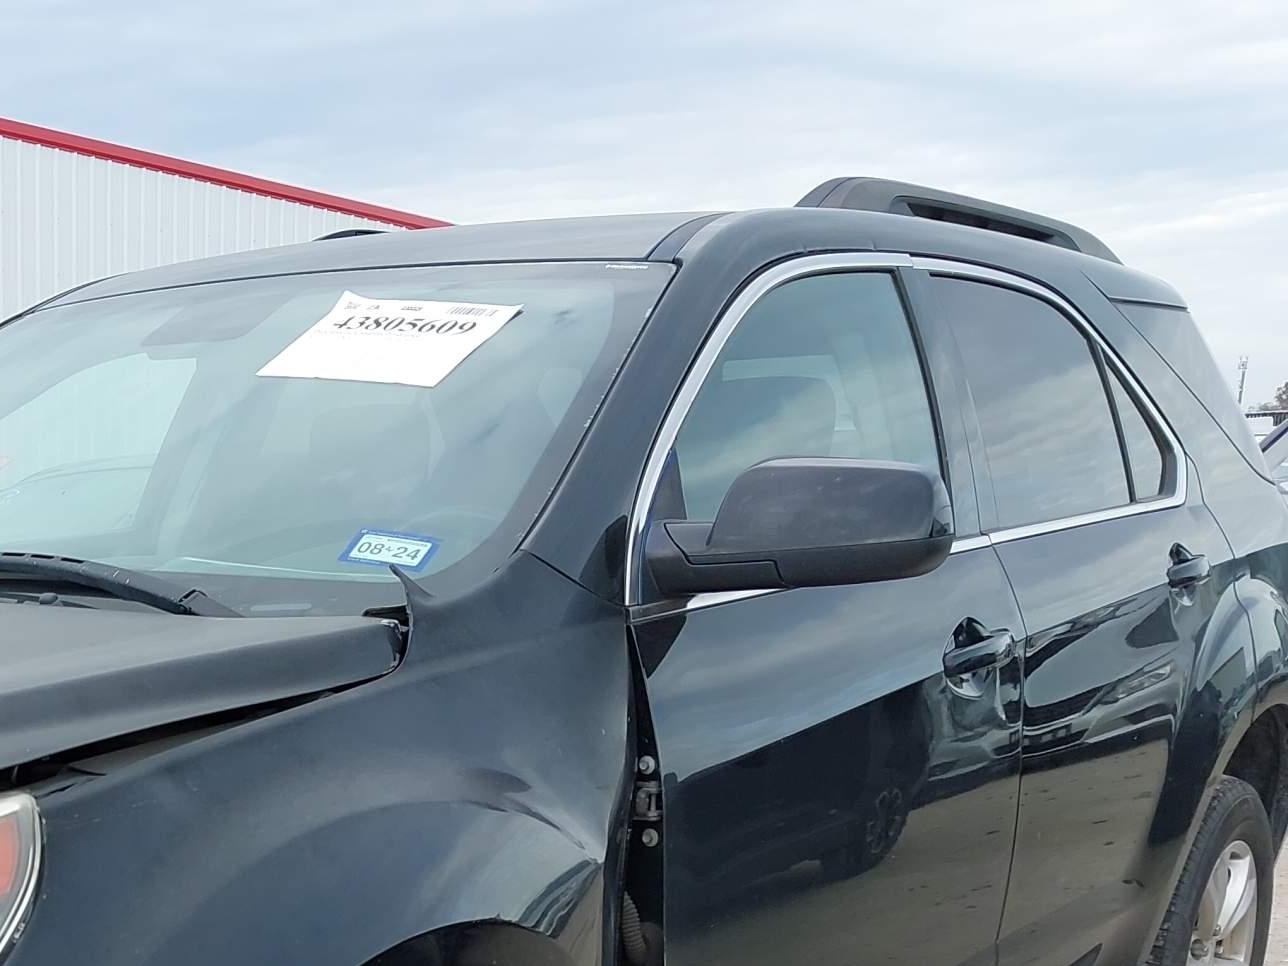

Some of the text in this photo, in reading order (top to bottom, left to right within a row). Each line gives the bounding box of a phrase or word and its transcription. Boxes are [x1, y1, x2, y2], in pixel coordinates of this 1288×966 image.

[333, 315, 477, 335] 43805609
[357, 541, 385, 555] 08
[392, 546, 422, 561] 24
